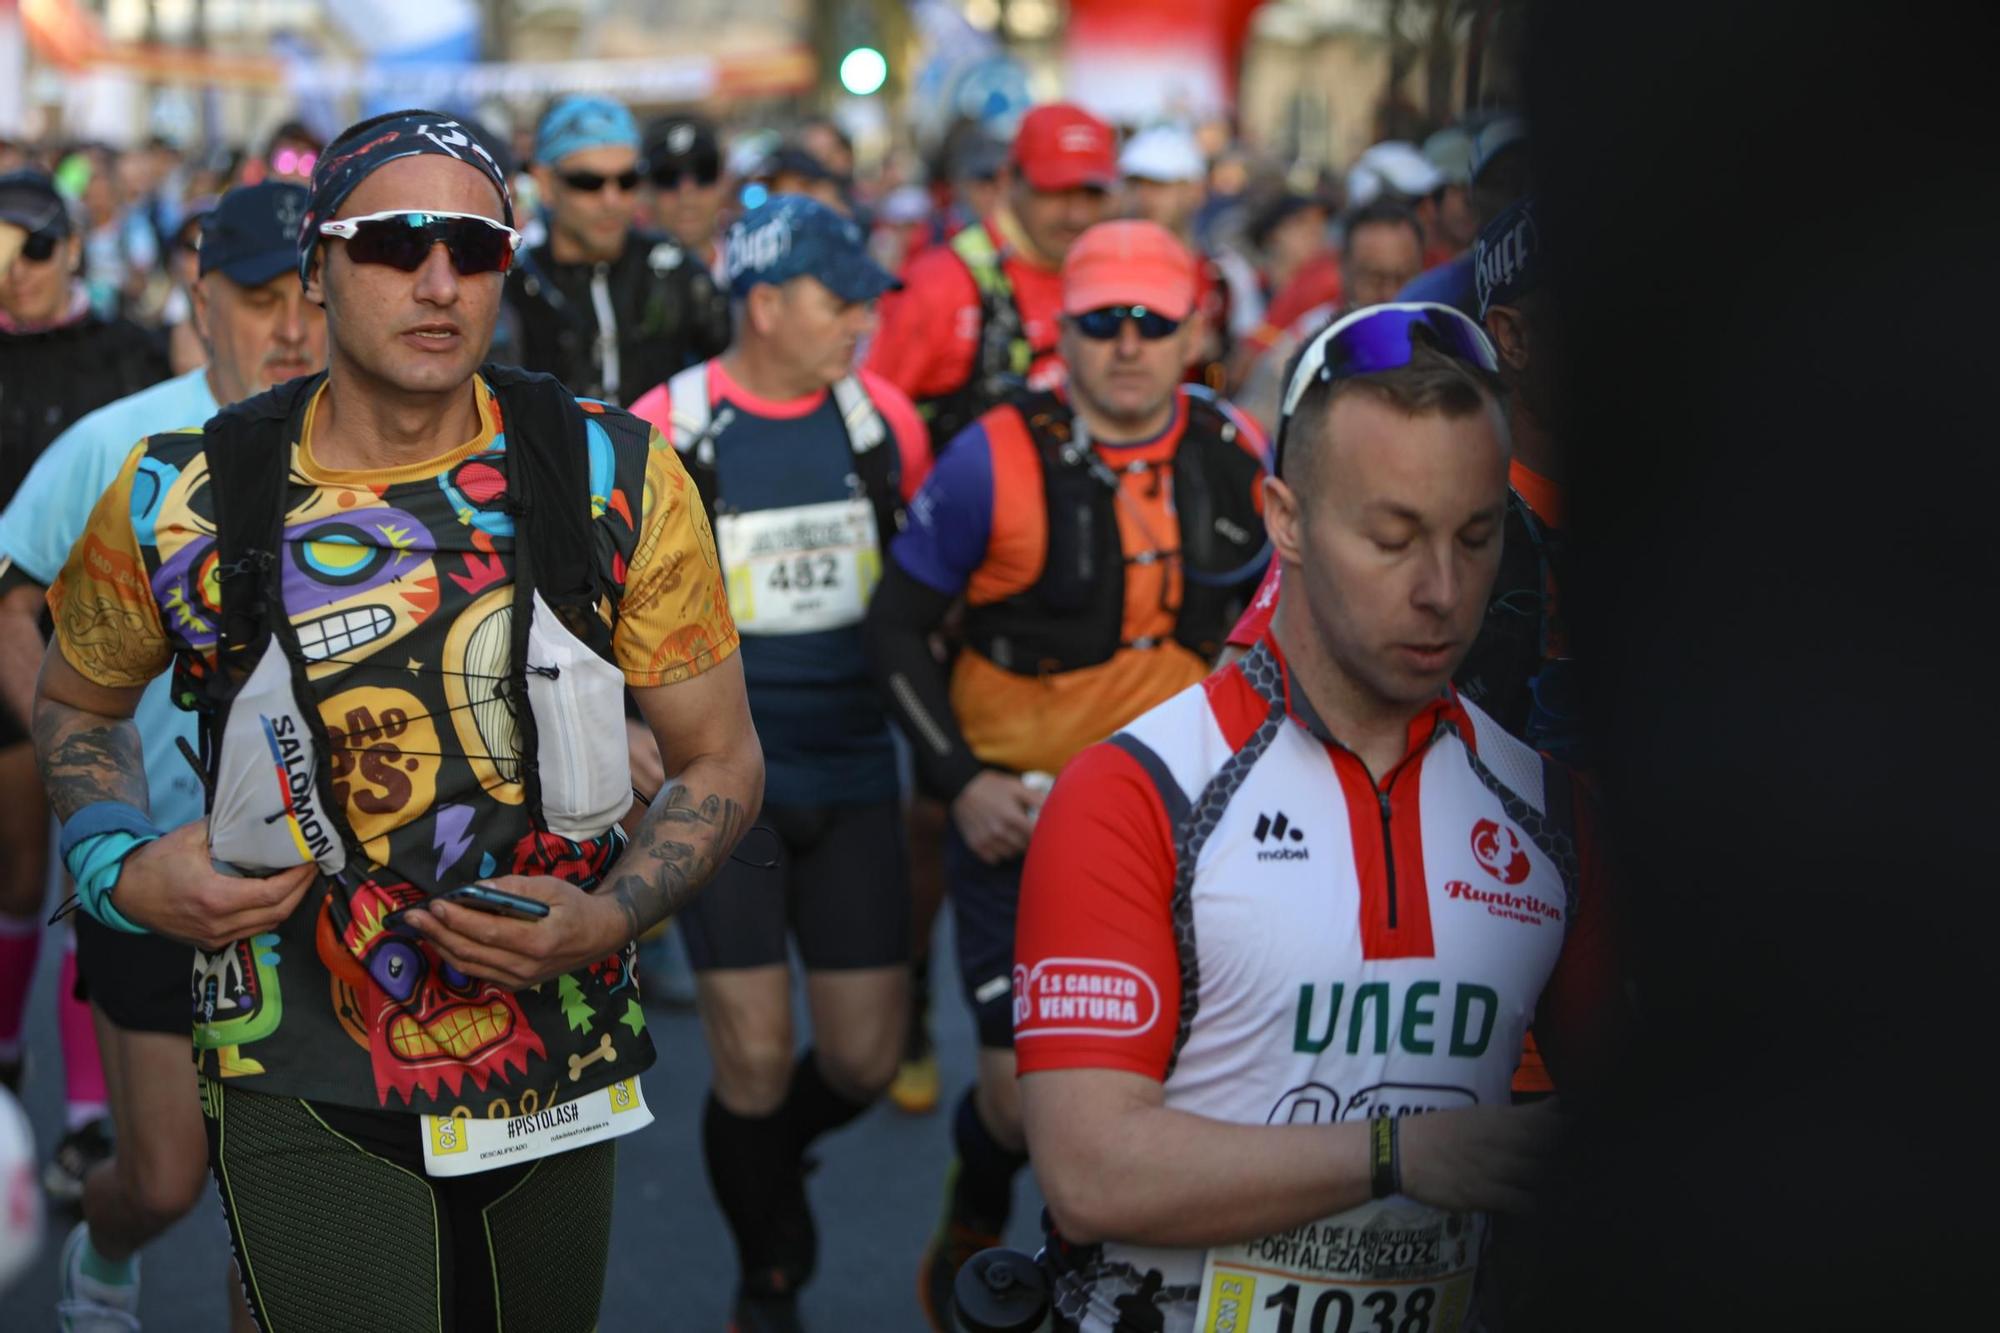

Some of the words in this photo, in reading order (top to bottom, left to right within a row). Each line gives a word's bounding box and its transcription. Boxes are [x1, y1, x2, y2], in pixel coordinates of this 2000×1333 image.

[768, 555, 840, 592] 482
[271, 714, 334, 860] SALOMON
[1444, 880, 1561, 920] Runtriton
[1064, 974, 1138, 998] CABEZO
[1039, 996, 1138, 1023] VENTURA
[1293, 981, 1499, 1058] UNED
[507, 1103, 579, 1139] #PISTOLAS#
[479, 1143, 528, 1160] DESCALIFICADO
[1247, 1236, 1374, 1276] FORTALEZAS
[1322, 1226, 1343, 1247] DE
[1347, 1229, 1377, 1250] LAS
[1264, 1282, 1437, 1333] 1038
